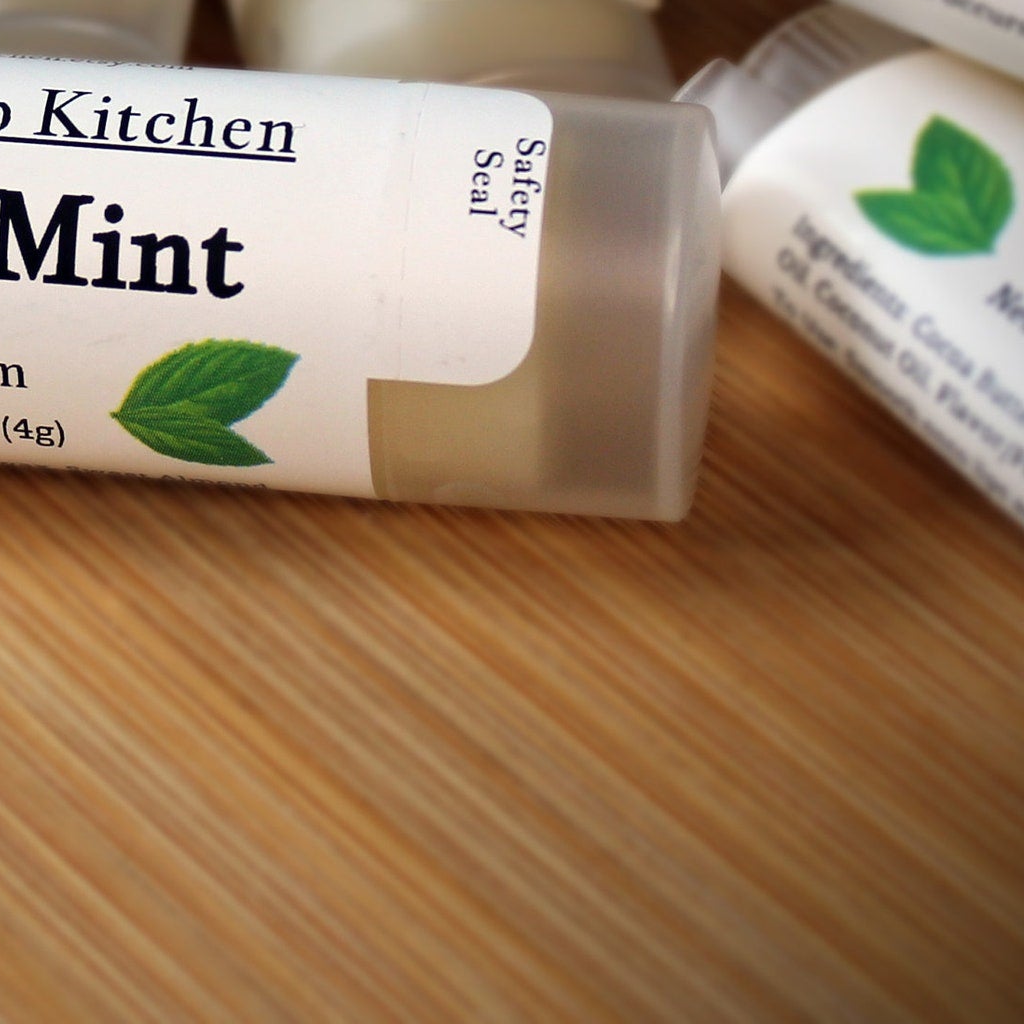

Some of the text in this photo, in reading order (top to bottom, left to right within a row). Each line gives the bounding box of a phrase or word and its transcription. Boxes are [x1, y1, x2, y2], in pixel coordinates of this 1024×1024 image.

[34, 88, 296, 155] Kitchen
[469, 148, 505, 216] Seal
[499, 137, 547, 238] Safety
[1, 415, 66, 448] (4g)
